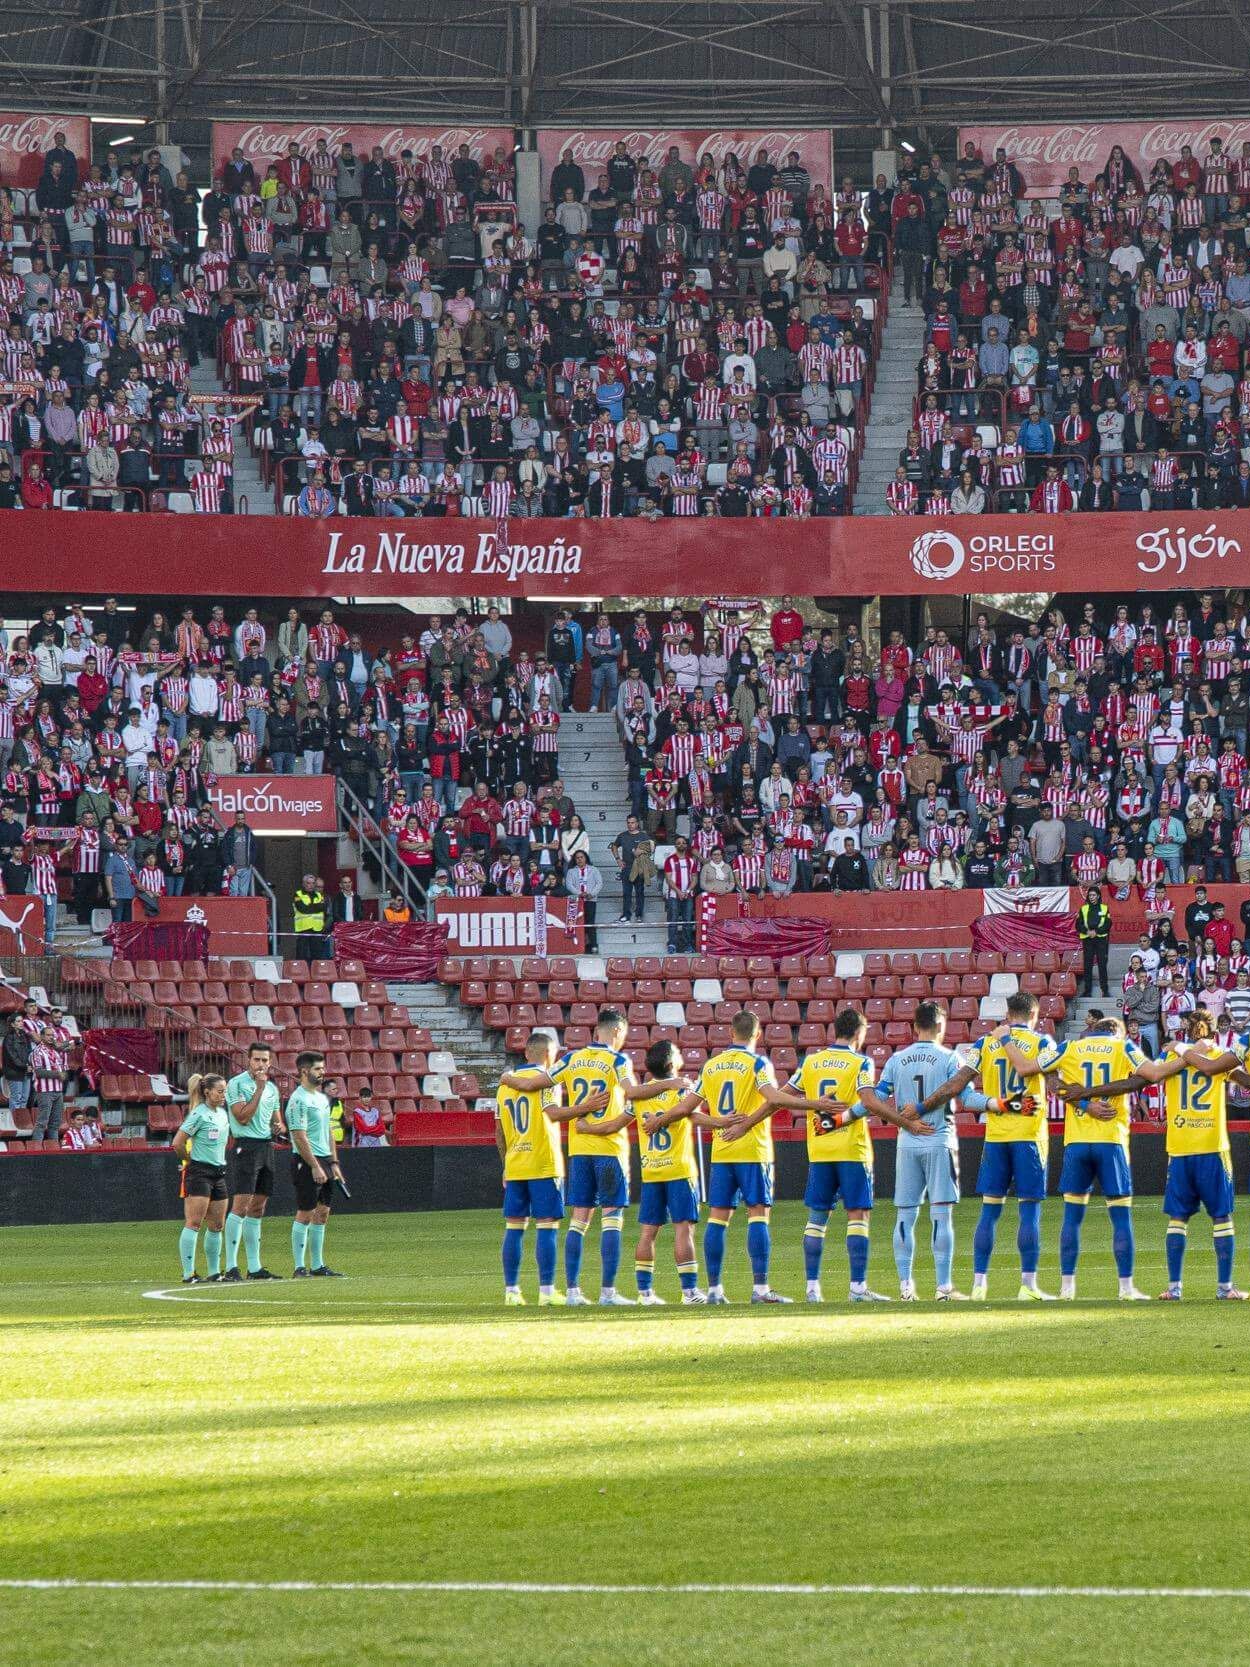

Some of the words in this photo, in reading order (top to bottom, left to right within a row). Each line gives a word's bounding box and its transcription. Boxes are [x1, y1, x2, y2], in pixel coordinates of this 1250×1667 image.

[993, 126, 1104, 164] Coca-Cola
[322, 532, 364, 573] La
[372, 532, 465, 573] Nueva
[471, 532, 583, 582] España
[970, 535, 1054, 552] ORLEGI
[1136, 523, 1241, 574] gijón
[970, 554, 1056, 572] SPORTS
[575, 723, 584, 732] 8
[583, 752, 591, 762] 7
[207, 781, 283, 812] Halcón
[282, 800, 323, 816] viajes
[591, 781, 599, 791] 6
[598, 812, 606, 821] 5
[437, 911, 536, 947] PUMA
[913, 1075, 924, 1103] 1
[994, 1058, 1025, 1098] 14
[1081, 1061, 1111, 1095] 11
[1179, 1068, 1213, 1110] 12
[504, 1095, 530, 1134] 10
[718, 1080, 735, 1116] 4
